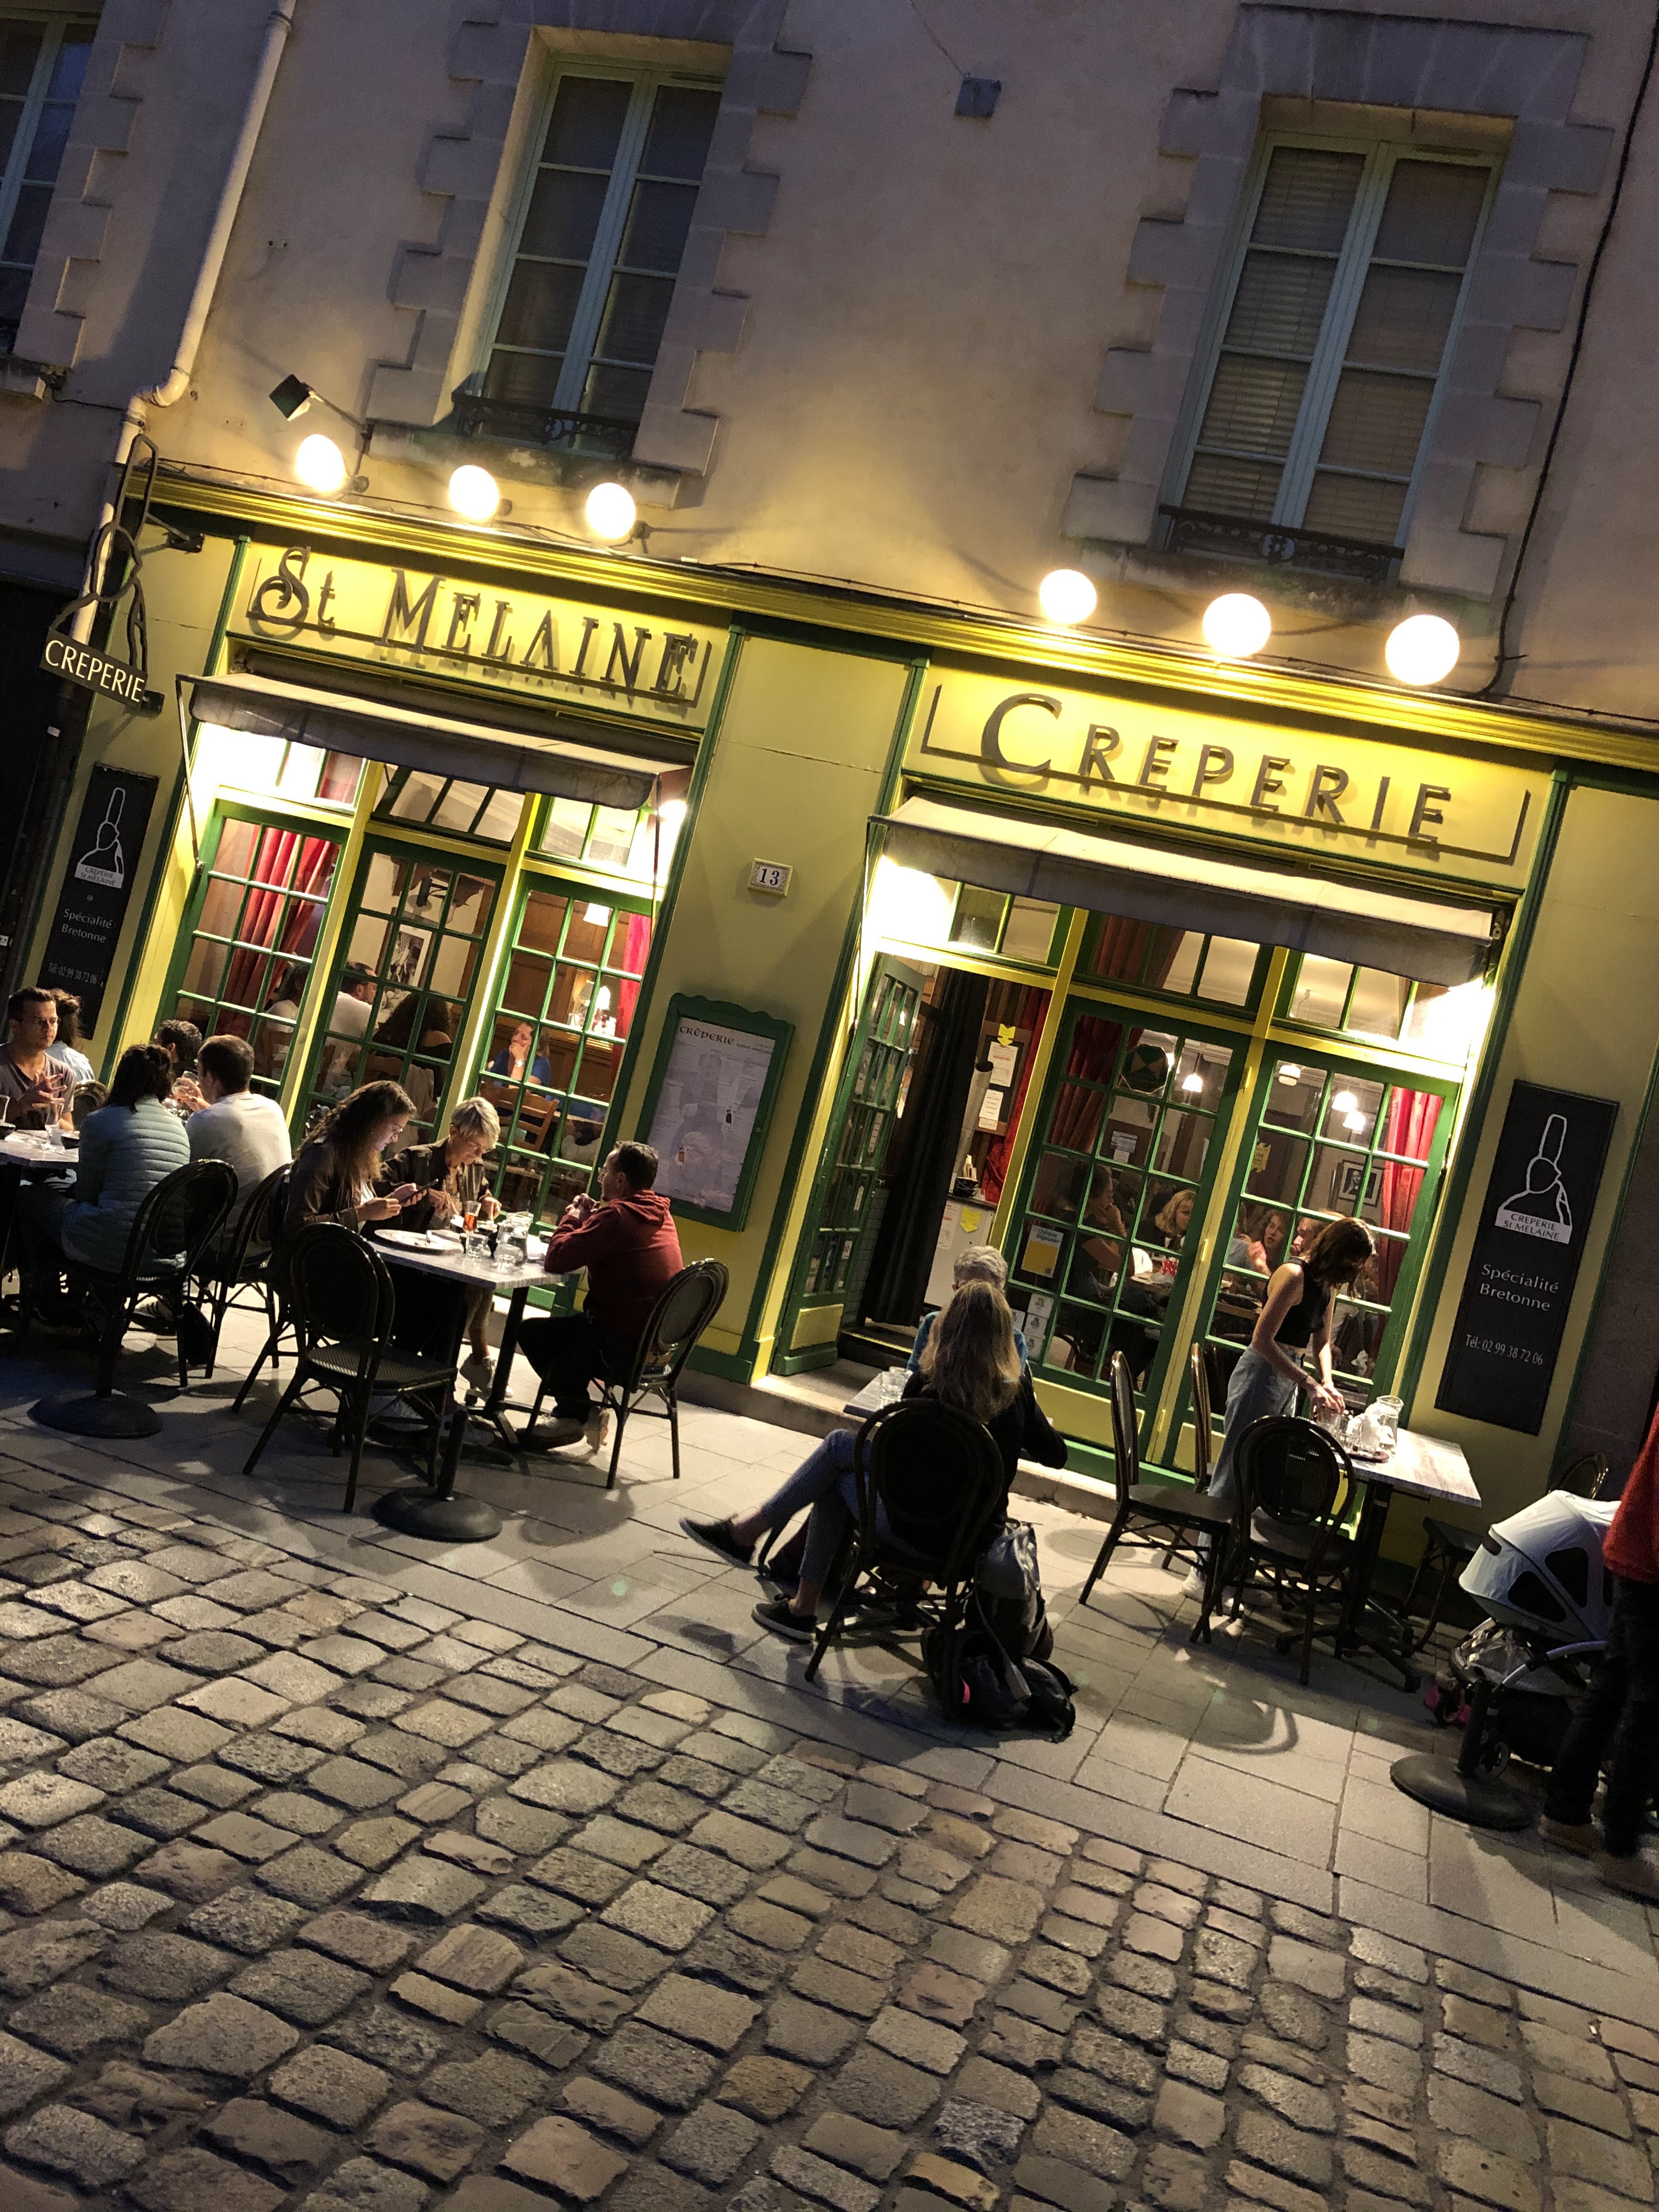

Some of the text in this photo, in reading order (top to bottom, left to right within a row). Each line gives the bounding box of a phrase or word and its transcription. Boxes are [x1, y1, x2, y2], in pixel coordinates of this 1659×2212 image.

[251, 546, 697, 697] St MELAINE
[45, 640, 145, 702] CREPERIE
[981, 692, 1452, 843] CREPERIE
[85, 867, 115, 879] CREPERIE
[87, 875, 116, 886] MELAINE
[759, 868, 780, 886] 13
[63, 909, 113, 928] Spécialité
[61, 923, 106, 943] Bretonne
[58, 966, 66, 975] 02
[66, 968, 74, 978] 99
[74, 970, 82, 980] 38
[82, 972, 89, 982] 72
[89, 974, 97, 984] 06
[680, 1026, 735, 1045] CRÊPERIE
[1510, 1213, 1558, 1231] CREPERIE
[1514, 1222, 1560, 1240] MELAINE
[1481, 1264, 1559, 1293] Spécialité
[1480, 1283, 1551, 1311] Bretonne
[1466, 1334, 1543, 1365] Tél: 02 99 38 72 06
